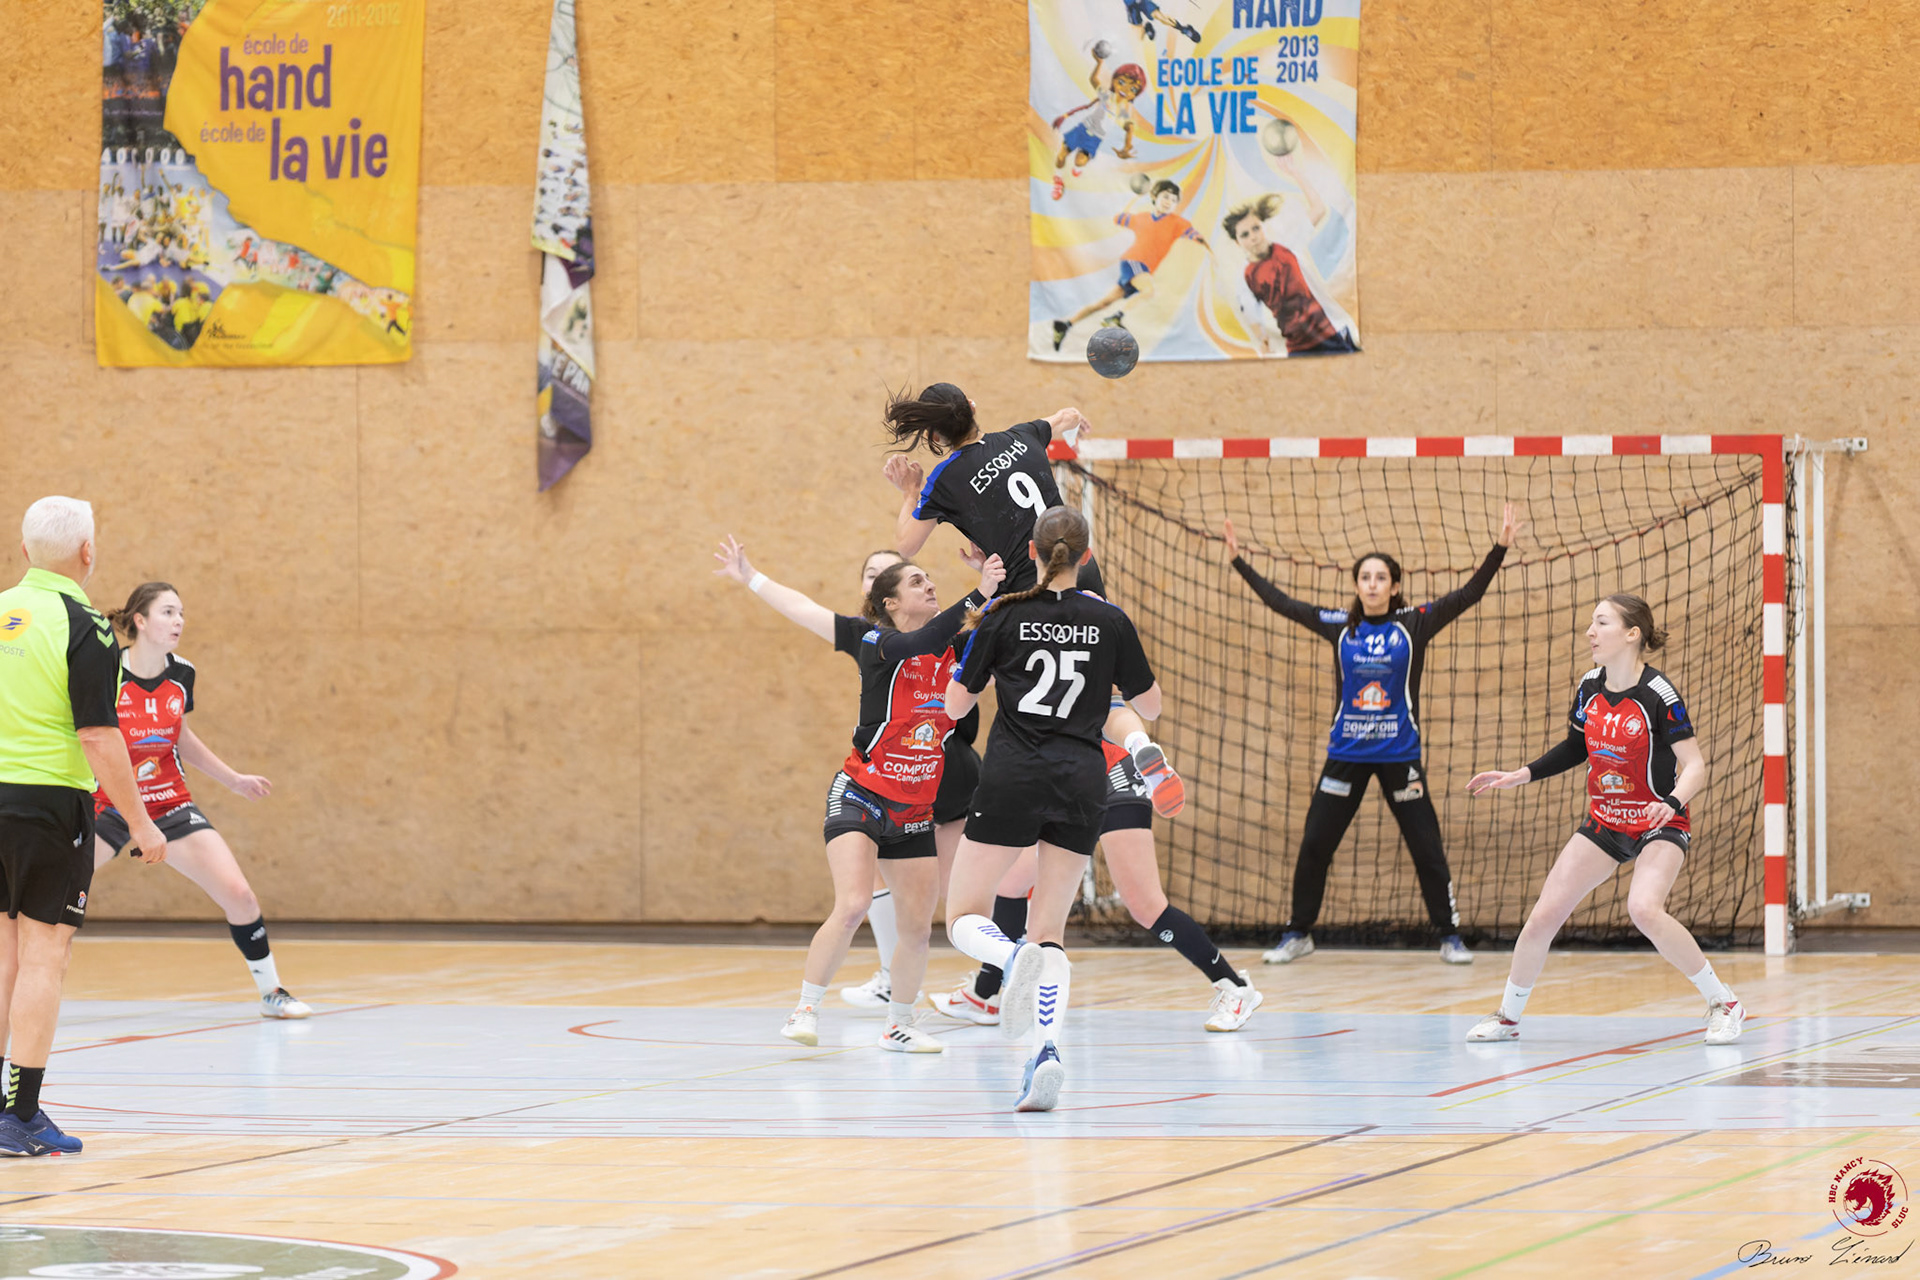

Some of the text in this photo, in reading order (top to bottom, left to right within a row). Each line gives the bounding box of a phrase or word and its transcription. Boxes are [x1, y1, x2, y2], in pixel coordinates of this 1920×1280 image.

[327, 3, 401, 28] 2011-2012
[1232, 0, 1324, 29] HAND
[243, 32, 309, 55] école de
[1278, 35, 1319, 58] 2013
[220, 44, 332, 112] hand
[1157, 49, 1259, 87] ÉCOLE DE
[1276, 60, 1319, 83] 2014
[1155, 91, 1258, 135] LA VIE
[200, 117, 388, 182] école de la vie
[1007, 471, 1047, 518] 9
[0, 645, 25, 657] POSTE
[1364, 633, 1386, 656] 12
[913, 691, 945, 701] Guy Hoq
[1018, 649, 1091, 719] 25
[145, 698, 159, 722] 4
[129, 726, 174, 737] Guy Hoquet
[1602, 712, 1622, 739] 11
[1588, 737, 1627, 753] Guy Hoquet
[141, 788, 178, 802] PTOIR
